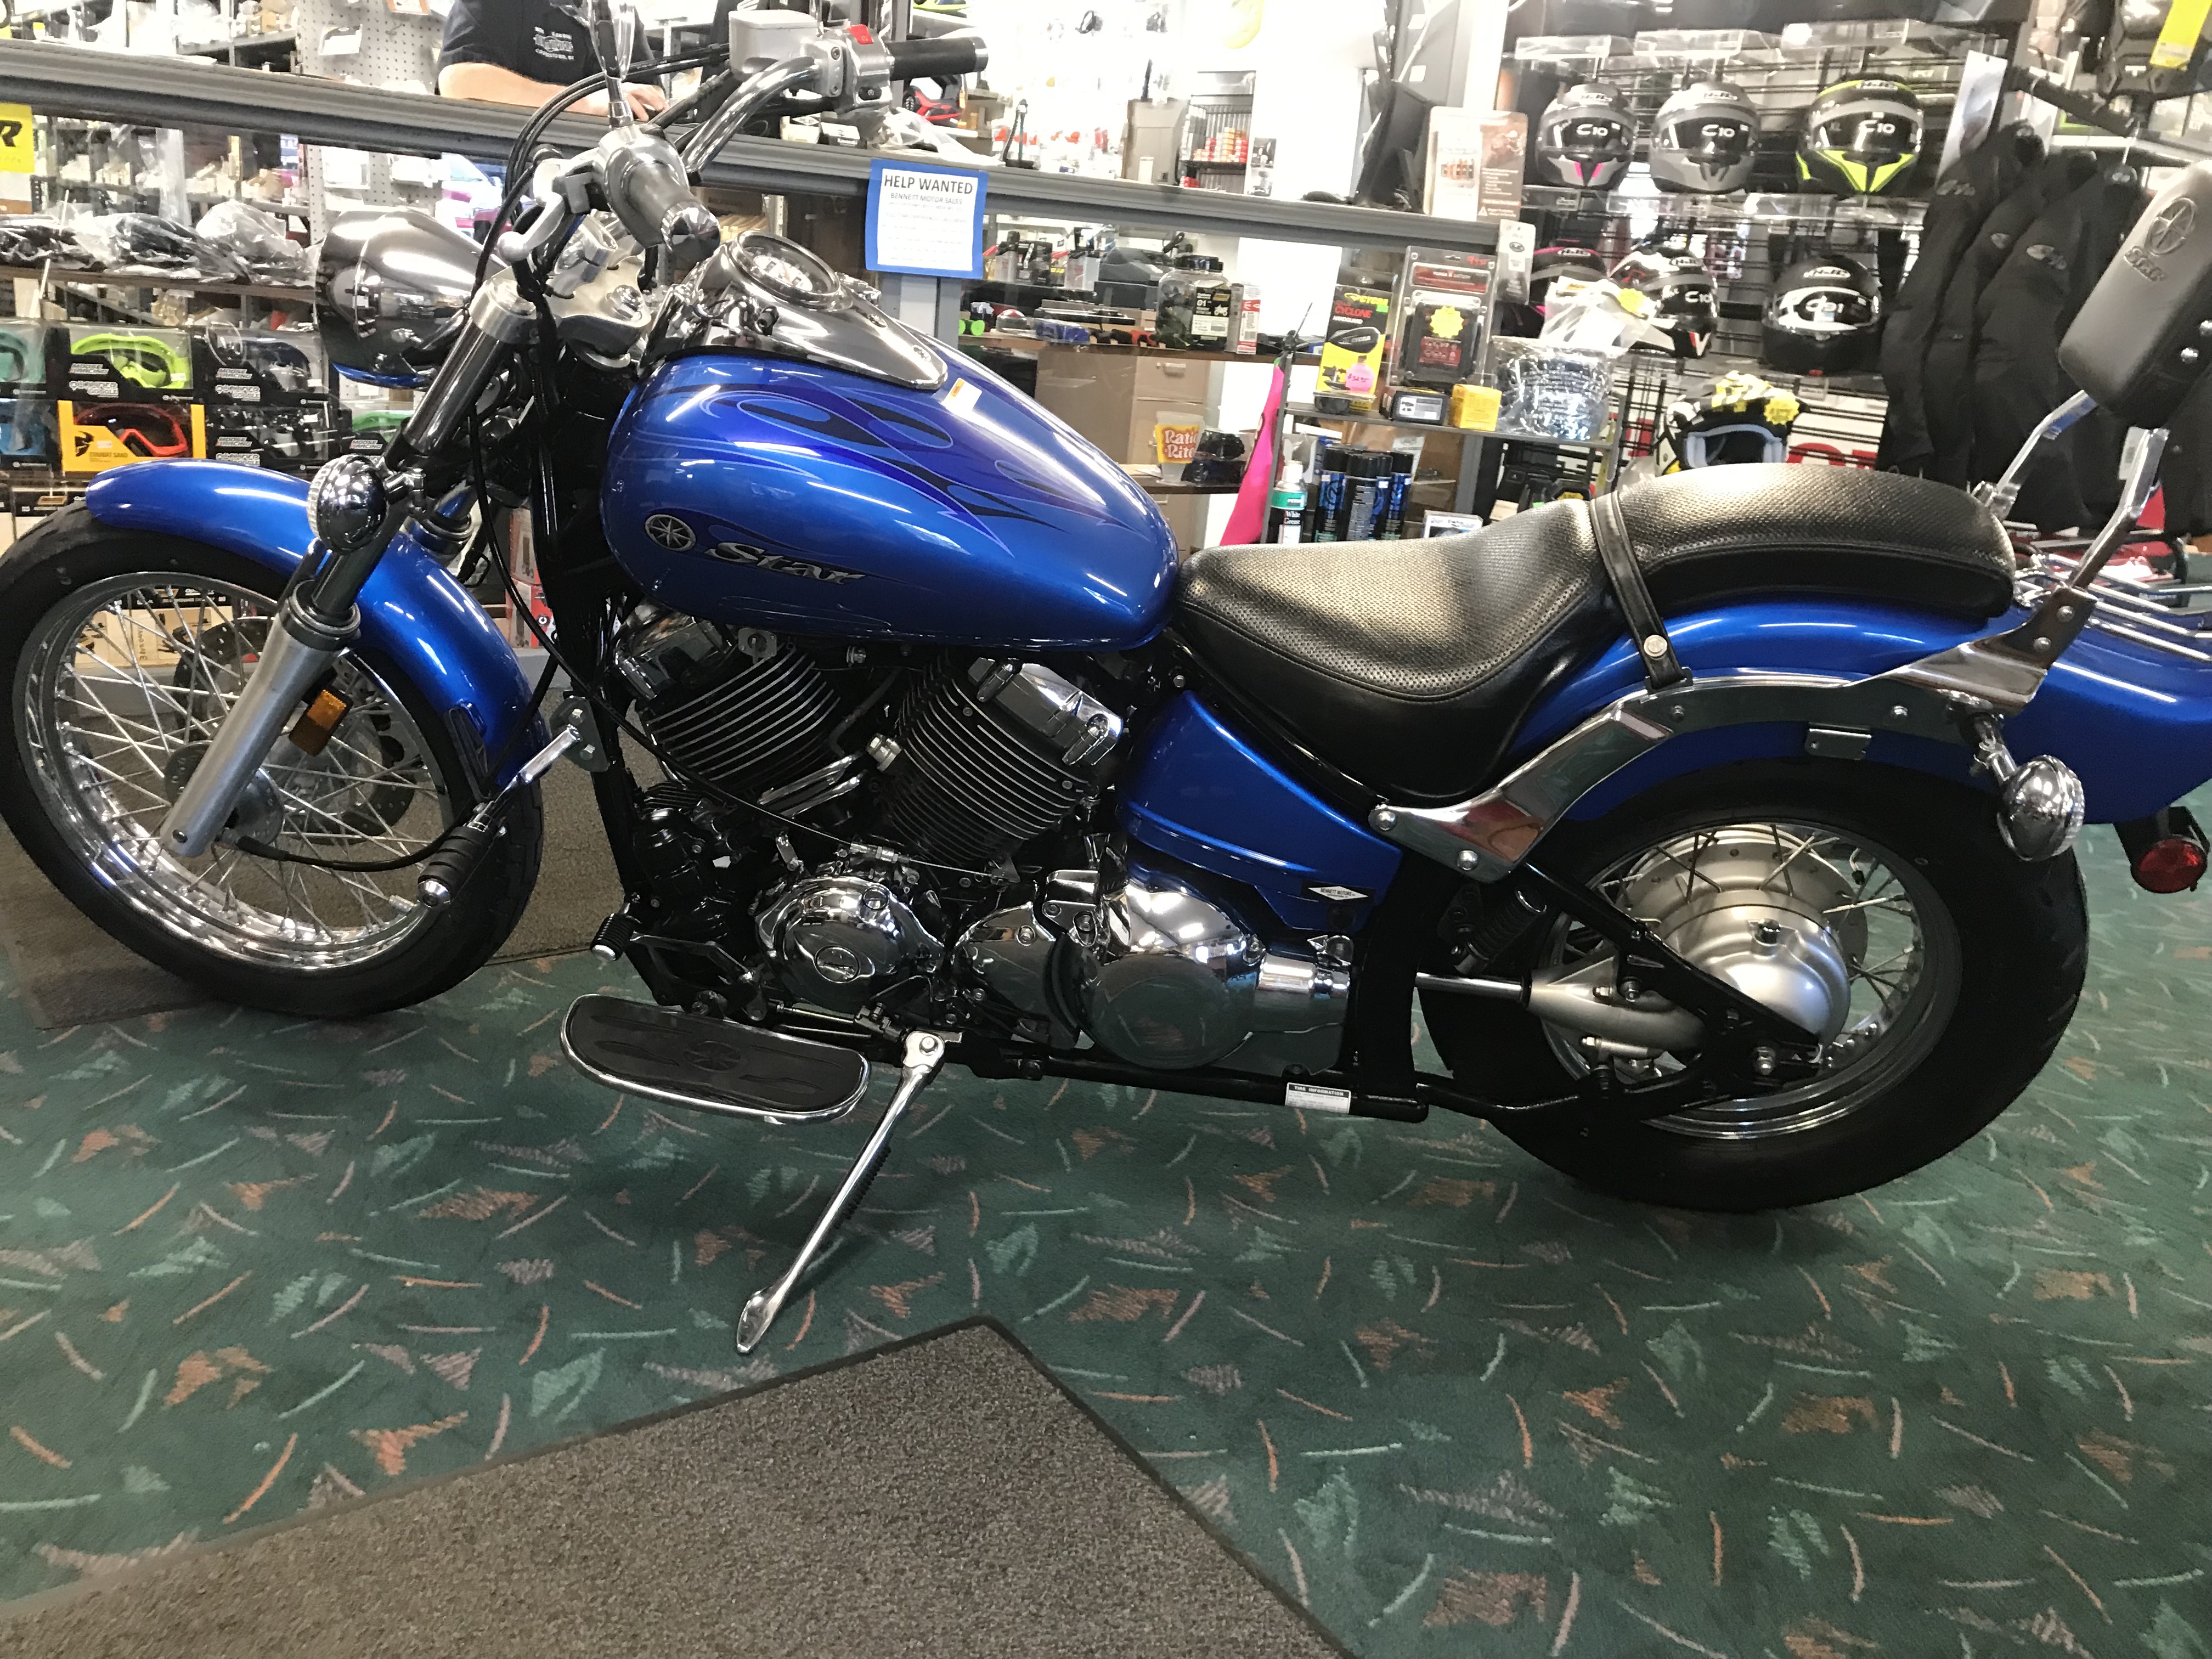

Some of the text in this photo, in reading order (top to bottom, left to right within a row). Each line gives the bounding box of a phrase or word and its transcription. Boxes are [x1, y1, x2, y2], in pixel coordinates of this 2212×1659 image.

[1576, 123, 1609, 137] C10
[1701, 124, 1735, 138] C10
[884, 174, 973, 194] HELP WANTED
[1334, 305, 1373, 318] CYCLONE
[704, 542, 865, 585] Star
[1308, 1087, 1344, 1096] INFORMATION
